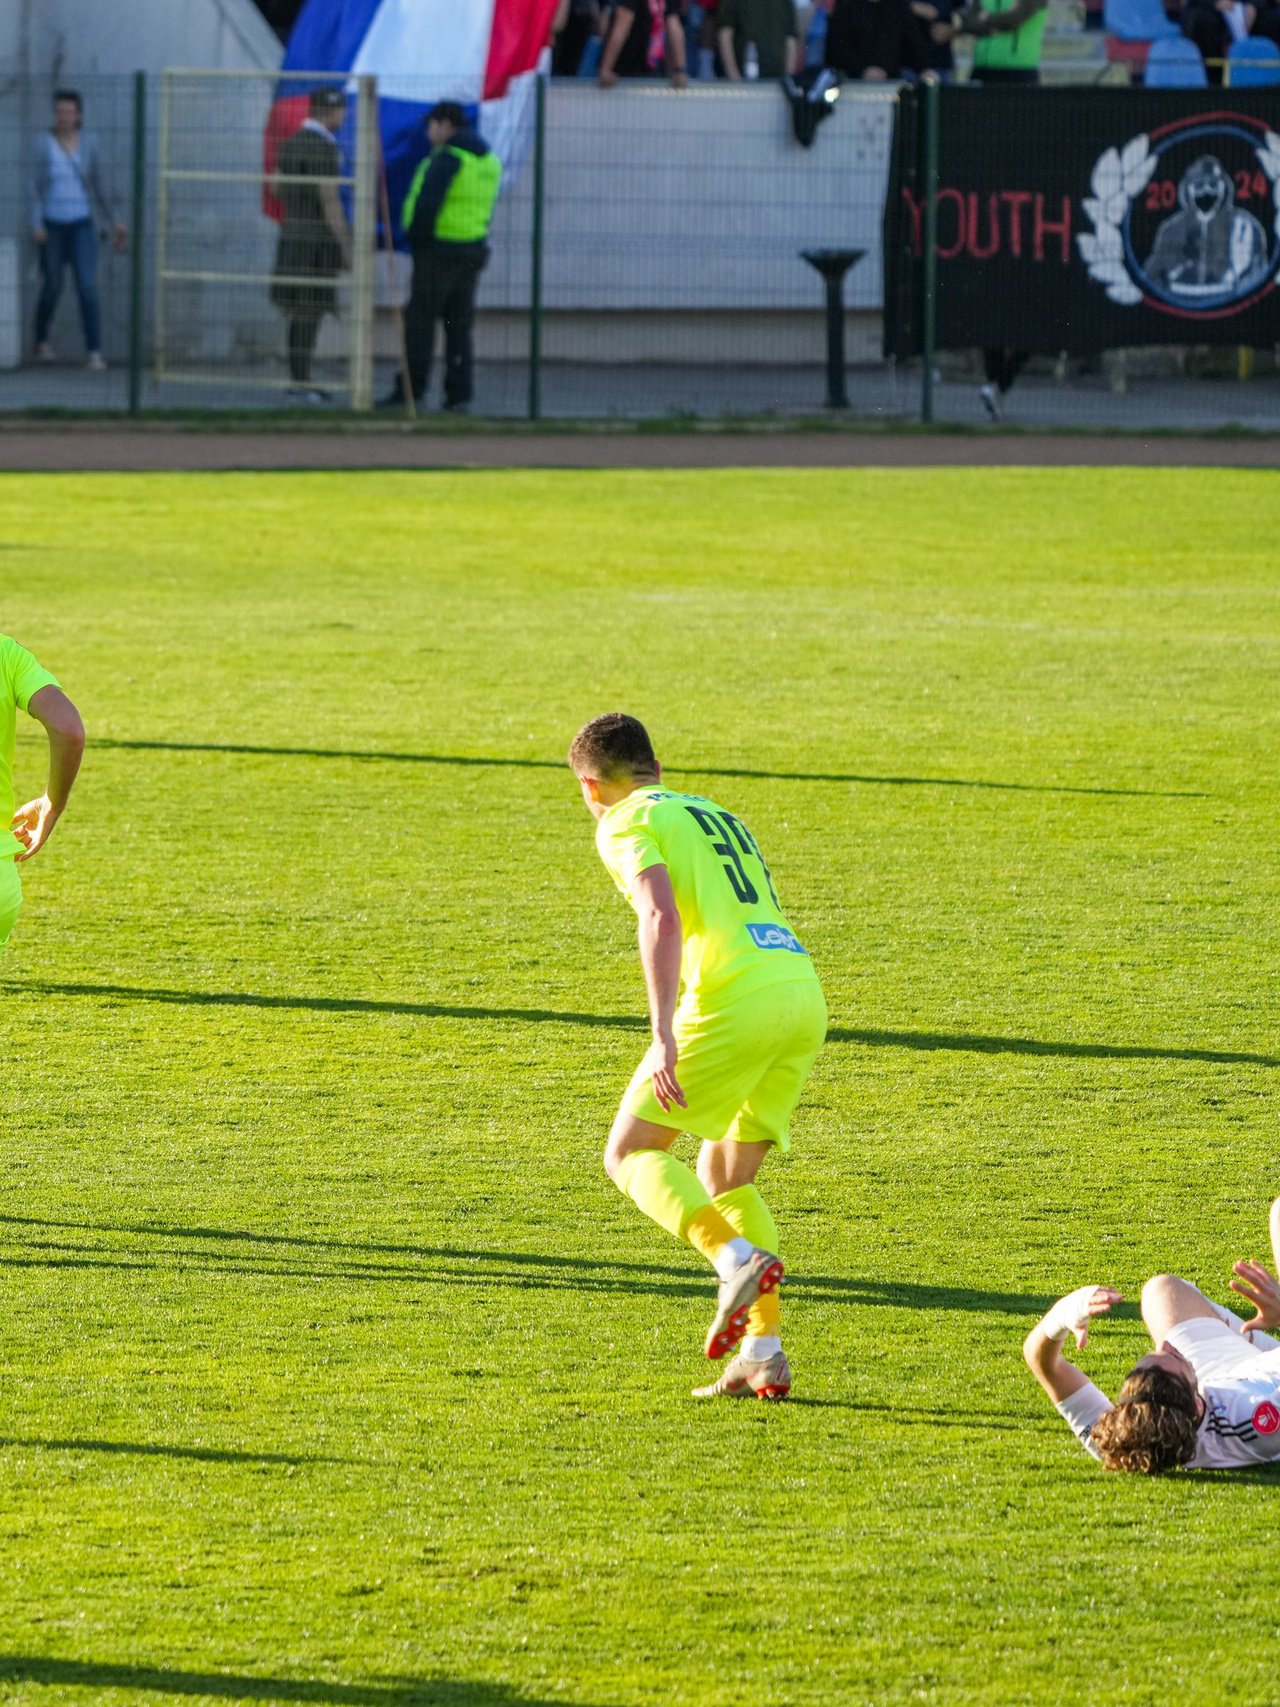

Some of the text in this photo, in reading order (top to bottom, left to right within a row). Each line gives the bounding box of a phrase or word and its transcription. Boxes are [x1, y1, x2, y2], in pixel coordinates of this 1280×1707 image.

[1145, 170, 1267, 210] 20 24
[902, 187, 1071, 264] YOUTH
